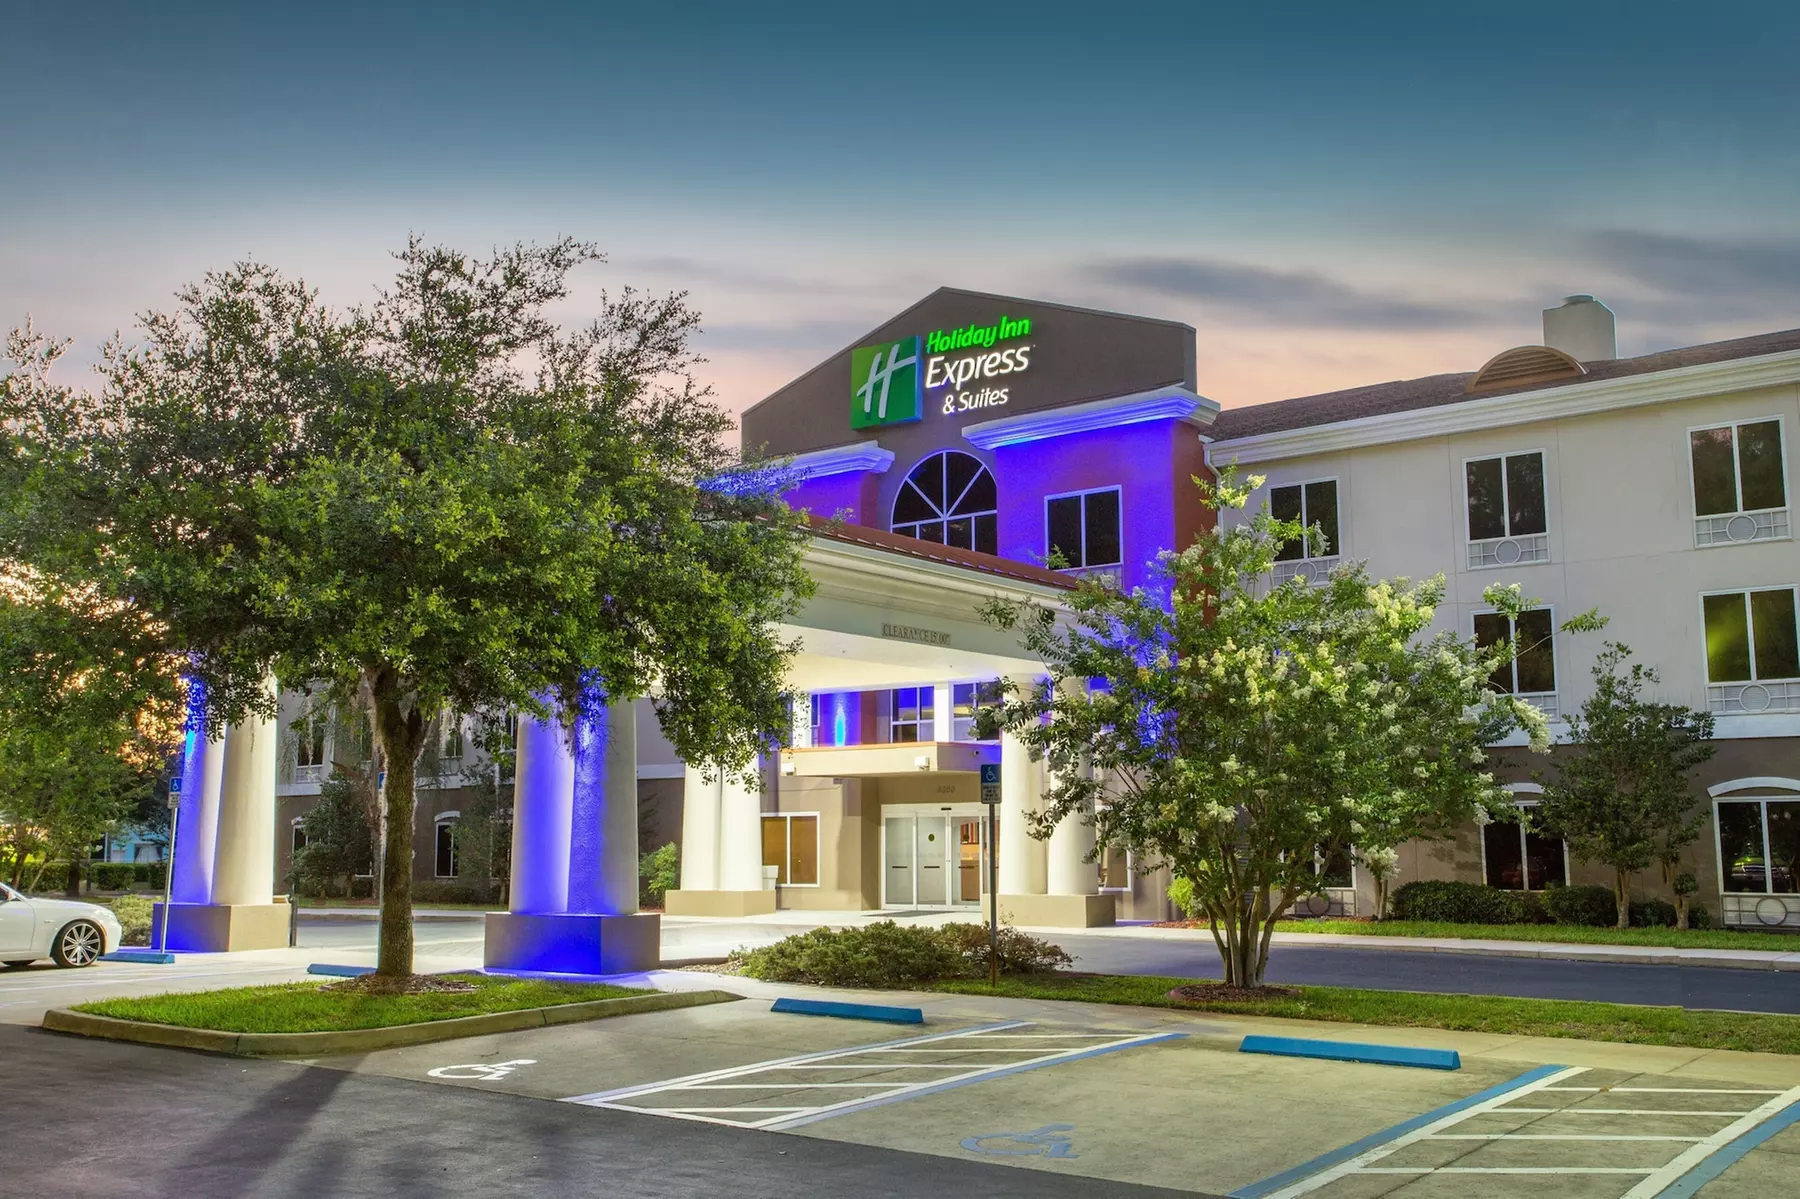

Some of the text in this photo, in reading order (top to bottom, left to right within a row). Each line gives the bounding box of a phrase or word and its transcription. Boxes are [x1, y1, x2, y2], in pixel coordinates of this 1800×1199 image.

[926, 316, 1032, 354] Holiday Inn
[925, 346, 1031, 391] Express
[942, 388, 1009, 415] & Suites
[883, 624, 929, 642] CLEARANCE
